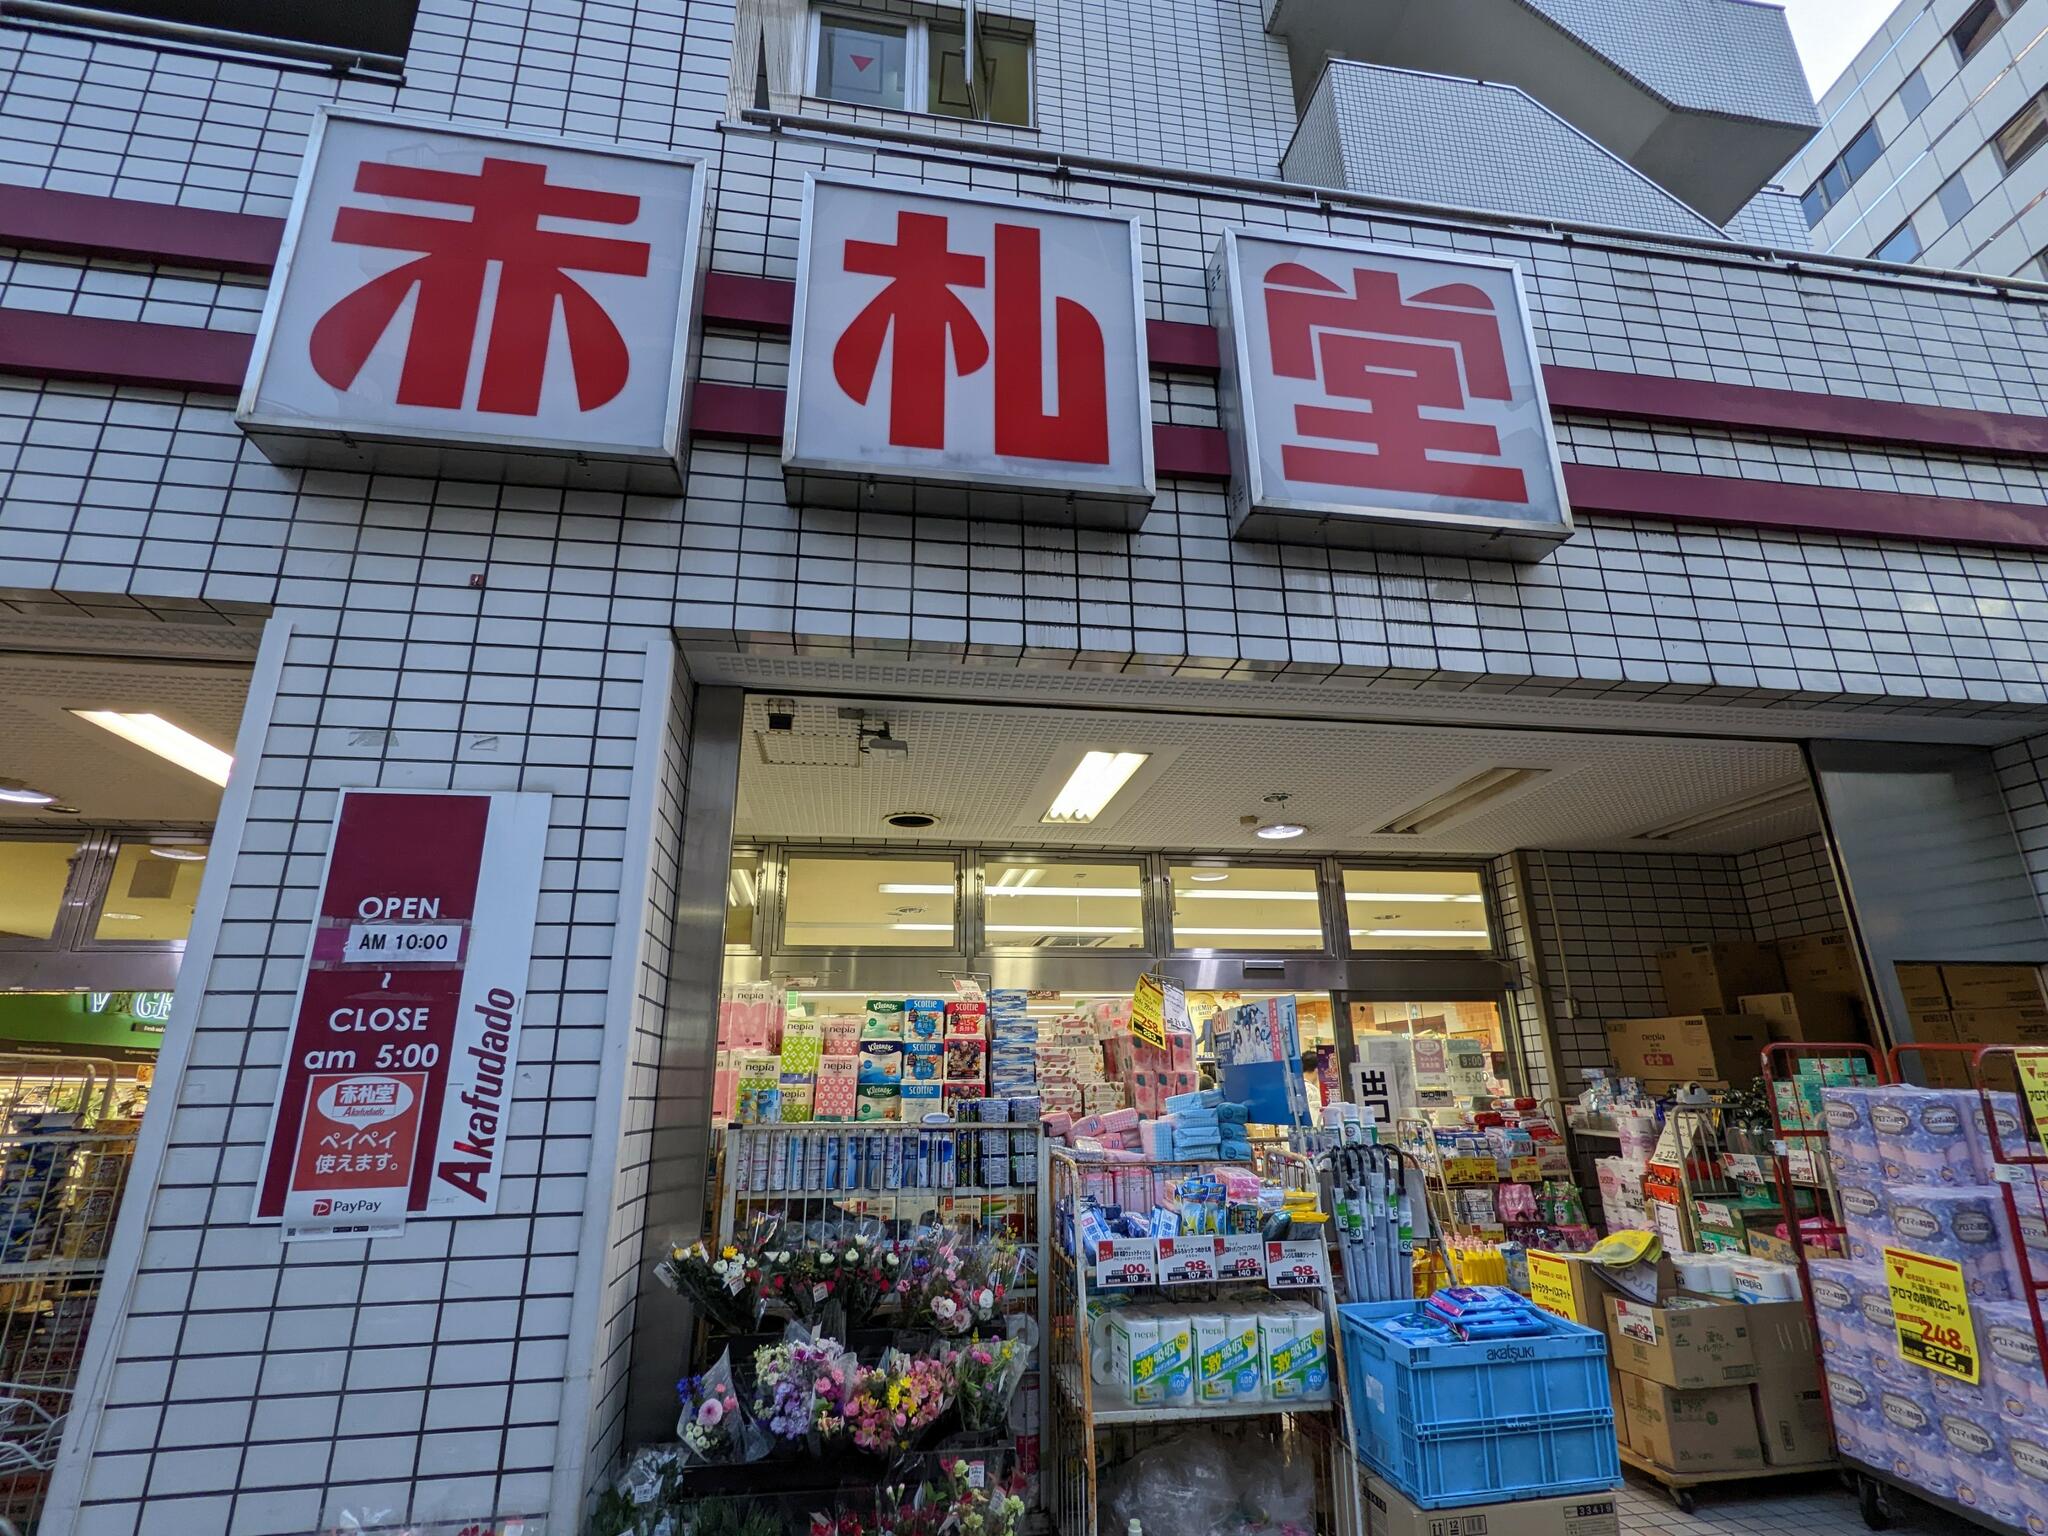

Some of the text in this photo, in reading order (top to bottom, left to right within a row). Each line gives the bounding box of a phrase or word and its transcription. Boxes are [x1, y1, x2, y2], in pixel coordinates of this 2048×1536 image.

[358, 896, 440, 920] OPEN
[358, 933, 449, 951] AM 10:00
[737, 991, 764, 1001] nepia
[329, 1007, 429, 1033] CLOSE
[787, 1022, 814, 1032] nepia
[829, 1026, 856, 1035] nepia
[1641, 1032, 1665, 1042] nepia
[304, 1043, 439, 1070] am 5:00
[745, 1063, 775, 1072] nepia
[824, 1062, 852, 1071] nepia
[339, 1084, 396, 1105] 赤札堂
[437, 987, 516, 1204] Akafudado
[1360, 1069, 1389, 1124] 出口
[320, 1130, 397, 1150] ペイペイ
[315, 1153, 398, 1175] 使えます。
[333, 1199, 382, 1214] PayPay
[1126, 1274, 1139, 1282] 110
[1187, 1271, 1201, 1280] 107
[1295, 1276, 1308, 1284] 107
[1486, 1346, 1535, 1362] akatsuki
[1449, 1520, 1459, 1529] 12
